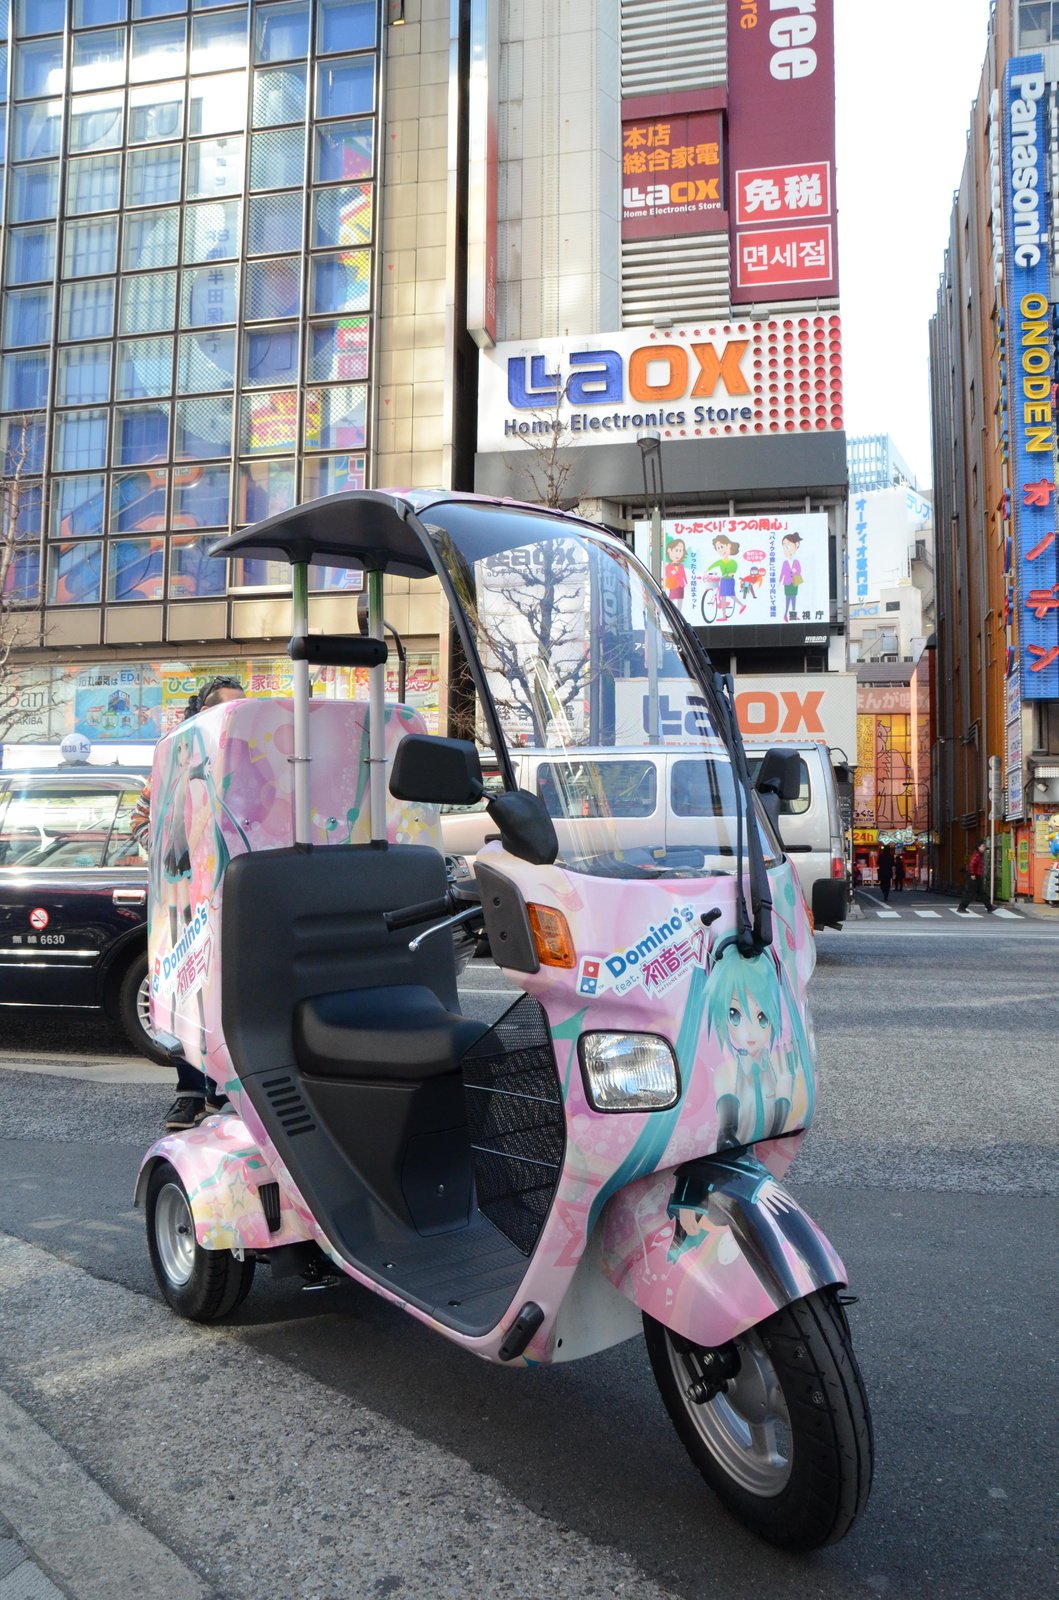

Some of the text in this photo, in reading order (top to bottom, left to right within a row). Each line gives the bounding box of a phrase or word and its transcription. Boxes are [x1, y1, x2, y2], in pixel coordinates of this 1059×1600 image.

[741, 0, 758, 29] re
[623, 124, 671, 150] 本店
[623, 143, 720, 175] 総合家電
[1011, 72, 1048, 268] Panasonic
[623, 201, 721, 218] Home Electronics Store
[744, 173, 822, 214] 免税
[743, 239, 826, 272] 면세점
[1020, 293, 1053, 453] ONODEN
[504, 405, 752, 436] Home Electronics Store
[855, 498, 868, 596] オーディオ専門店
[1023, 478, 1059, 673] オノデン
[853, 832, 874, 842] 24h
[40, 935, 65, 945] 6630
[162, 907, 208, 980] Domino's
[605, 907, 694, 978] Domino's
[641, 929, 705, 986] 初音ミク
[615, 975, 640, 994] feat.
